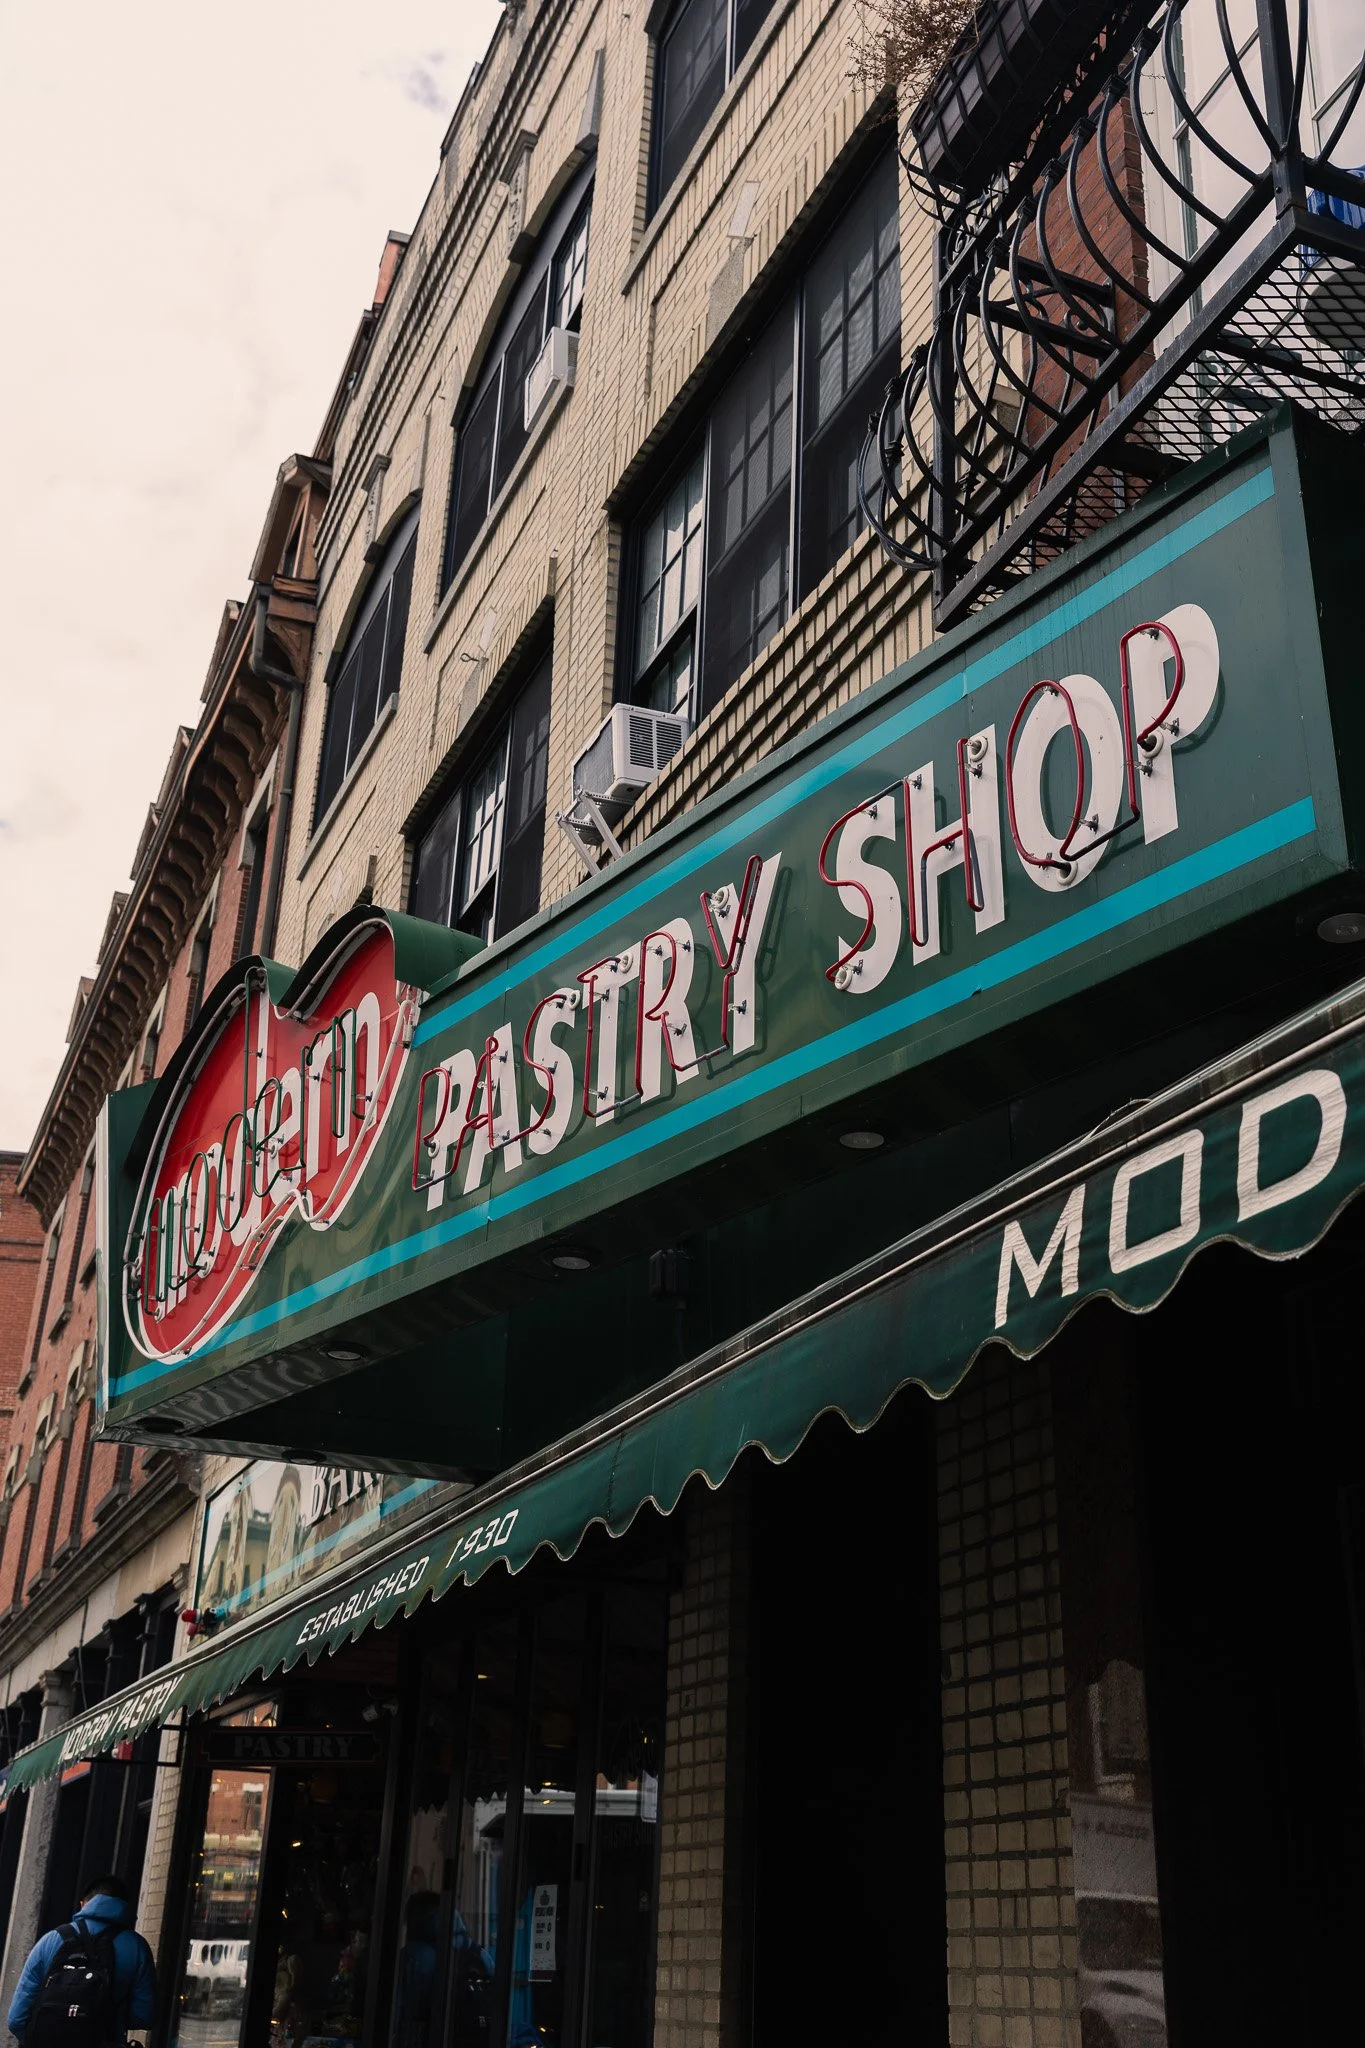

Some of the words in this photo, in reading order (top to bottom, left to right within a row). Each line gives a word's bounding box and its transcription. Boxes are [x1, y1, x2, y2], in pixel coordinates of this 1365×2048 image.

[413, 851, 783, 1212] PASTRY
[819, 602, 1220, 994] SHOP
[994, 1069, 1347, 1329] MOD
[295, 1556, 430, 1646] ESTABLISHED
[445, 1509, 520, 1569] 1930
[57, 1706, 119, 1765] MODERN
[116, 1673, 185, 1733] PASTRY
[233, 1735, 354, 1758] PASTRY
